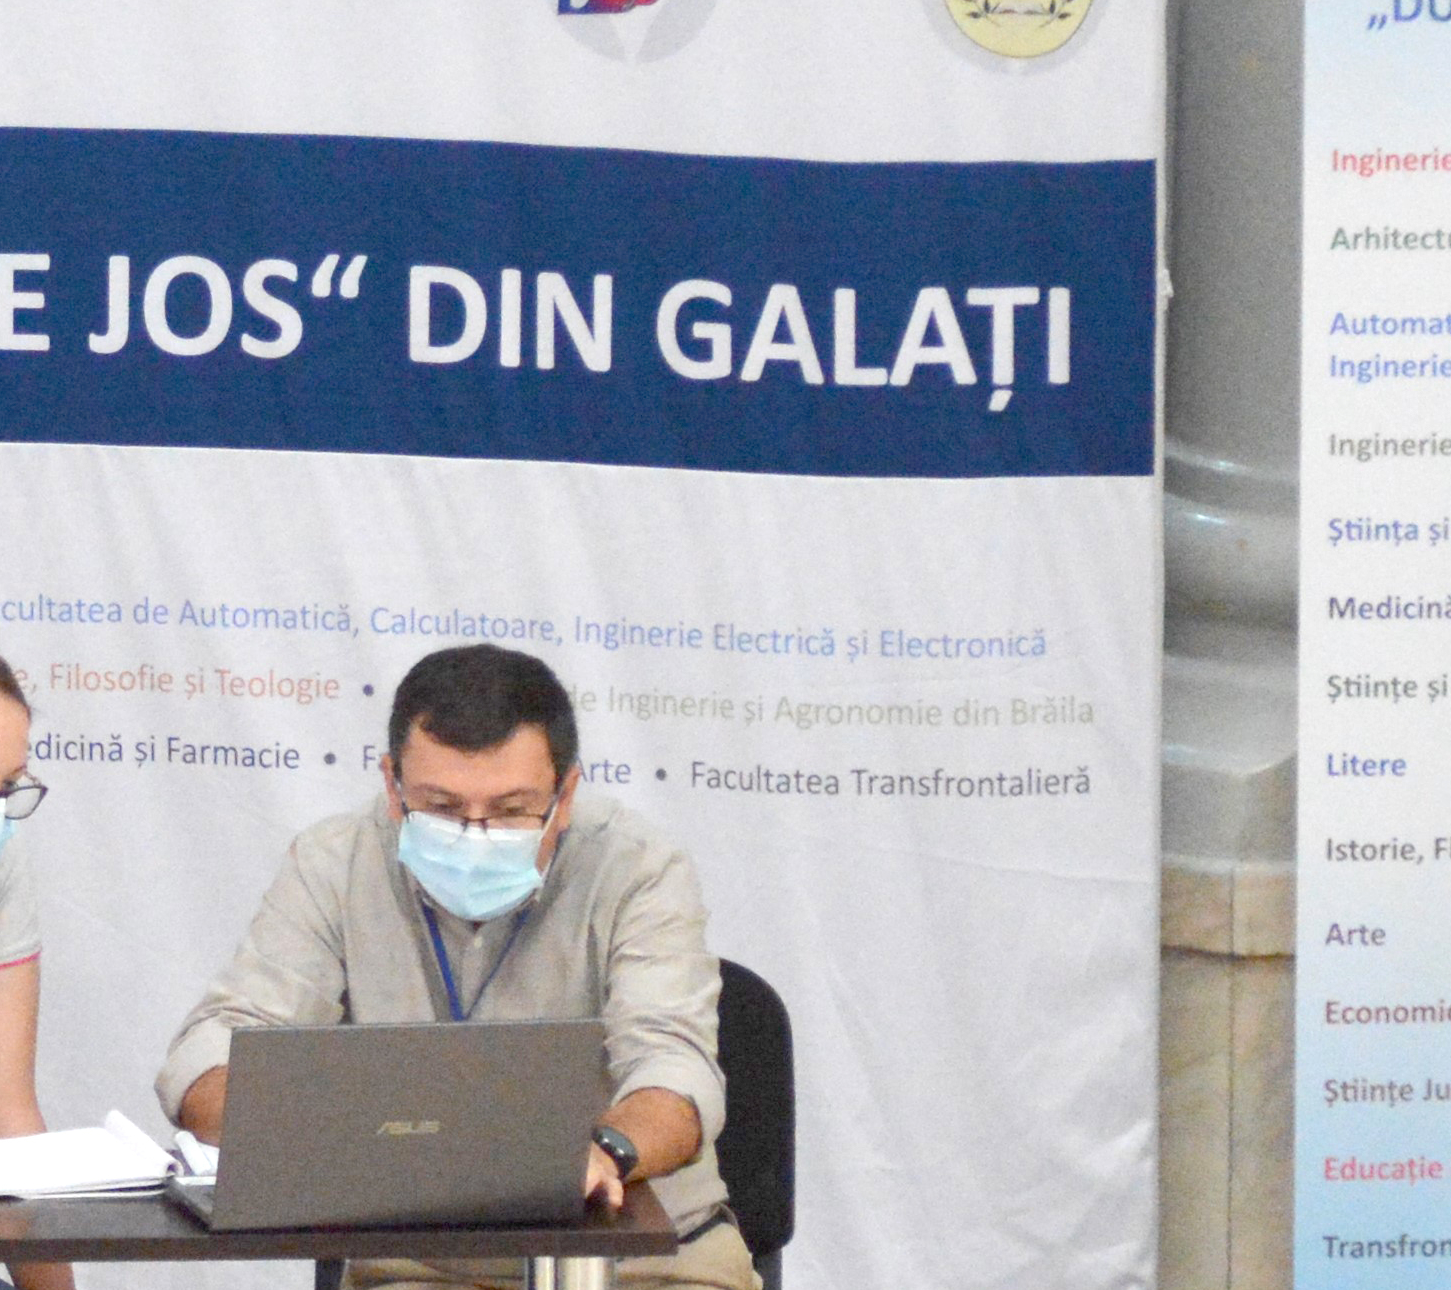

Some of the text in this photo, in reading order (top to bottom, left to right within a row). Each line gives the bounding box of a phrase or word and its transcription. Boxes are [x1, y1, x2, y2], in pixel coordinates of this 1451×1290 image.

[409, 265, 612, 372] DIN
[656, 279, 1070, 411] GALAȚI
[1328, 517, 1419, 547] Știința
[1428, 517, 1450, 546] și
[132, 597, 170, 625] de
[178, 599, 360, 638] Automatică,
[370, 606, 563, 643] Calculatoare,
[575, 616, 703, 651] Inginerie
[712, 622, 836, 657] Electrică
[846, 630, 868, 663] și
[879, 629, 1047, 659] Electronică
[50, 662, 173, 693] Filosofie
[185, 667, 206, 699] și
[213, 667, 340, 705] Teologie
[609, 687, 735, 721] Inginerie
[742, 692, 764, 727] și
[774, 696, 942, 730] Agronomie
[951, 698, 1000, 727] din
[1010, 695, 1095, 726] Brăila
[1327, 674, 1418, 704] Științe
[1427, 673, 1448, 703] și
[27, 732, 123, 762] dicină
[135, 735, 156, 767] și
[166, 736, 300, 770] Farmacie
[691, 760, 840, 796] Facultatea
[850, 766, 1090, 798] Transfrontalieră
[1326, 753, 1407, 777] Litere
[1326, 837, 1424, 865] Istorie,
[1325, 922, 1386, 946] Arte
[1323, 1078, 1414, 1107] Științe
[377, 1120, 441, 1138] ASUS
[1323, 1156, 1444, 1184] Educație
